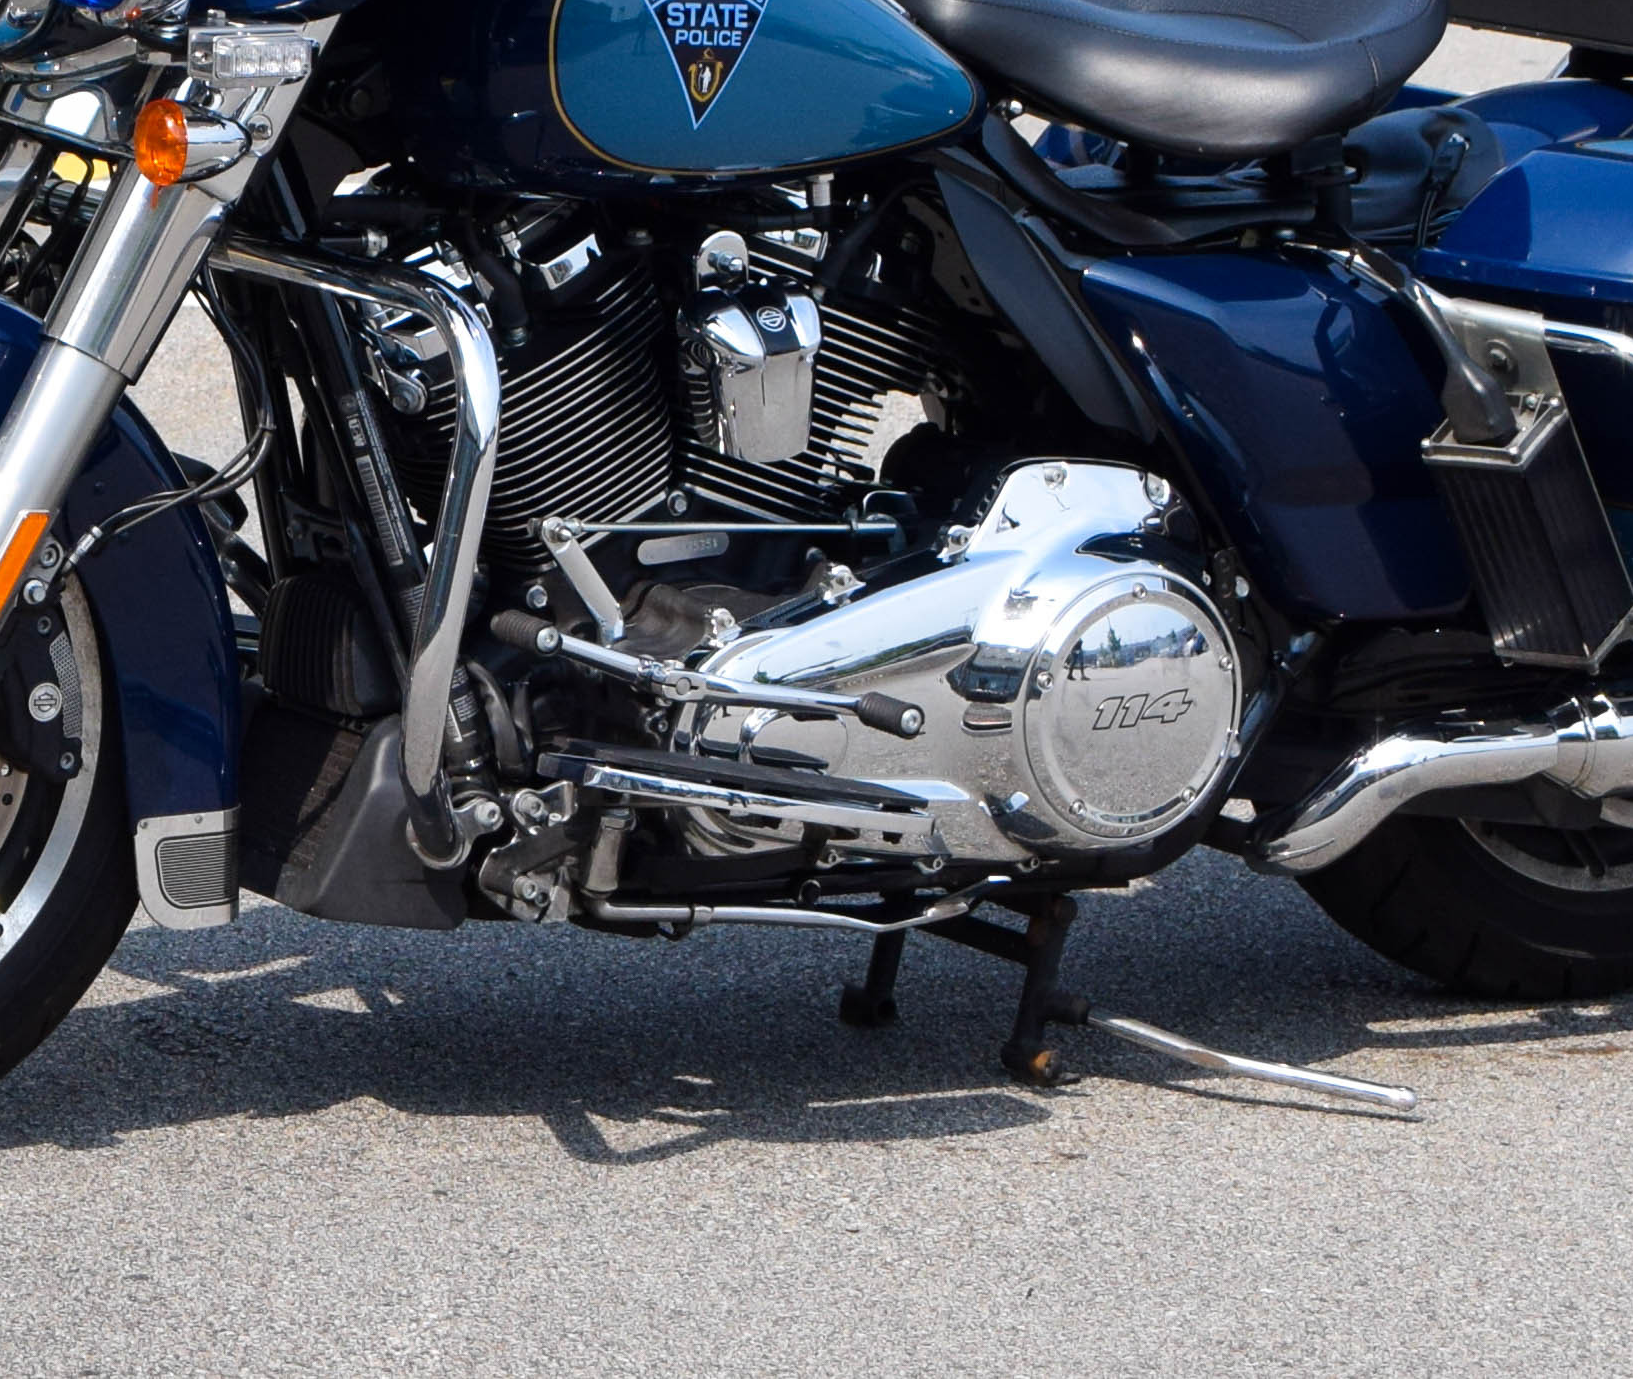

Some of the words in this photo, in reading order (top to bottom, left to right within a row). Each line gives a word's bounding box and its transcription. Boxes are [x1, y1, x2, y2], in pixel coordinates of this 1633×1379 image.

[666, 2, 749, 28] STATE
[674, 29, 742, 47] POLICE
[1092, 688, 1194, 731] 114
